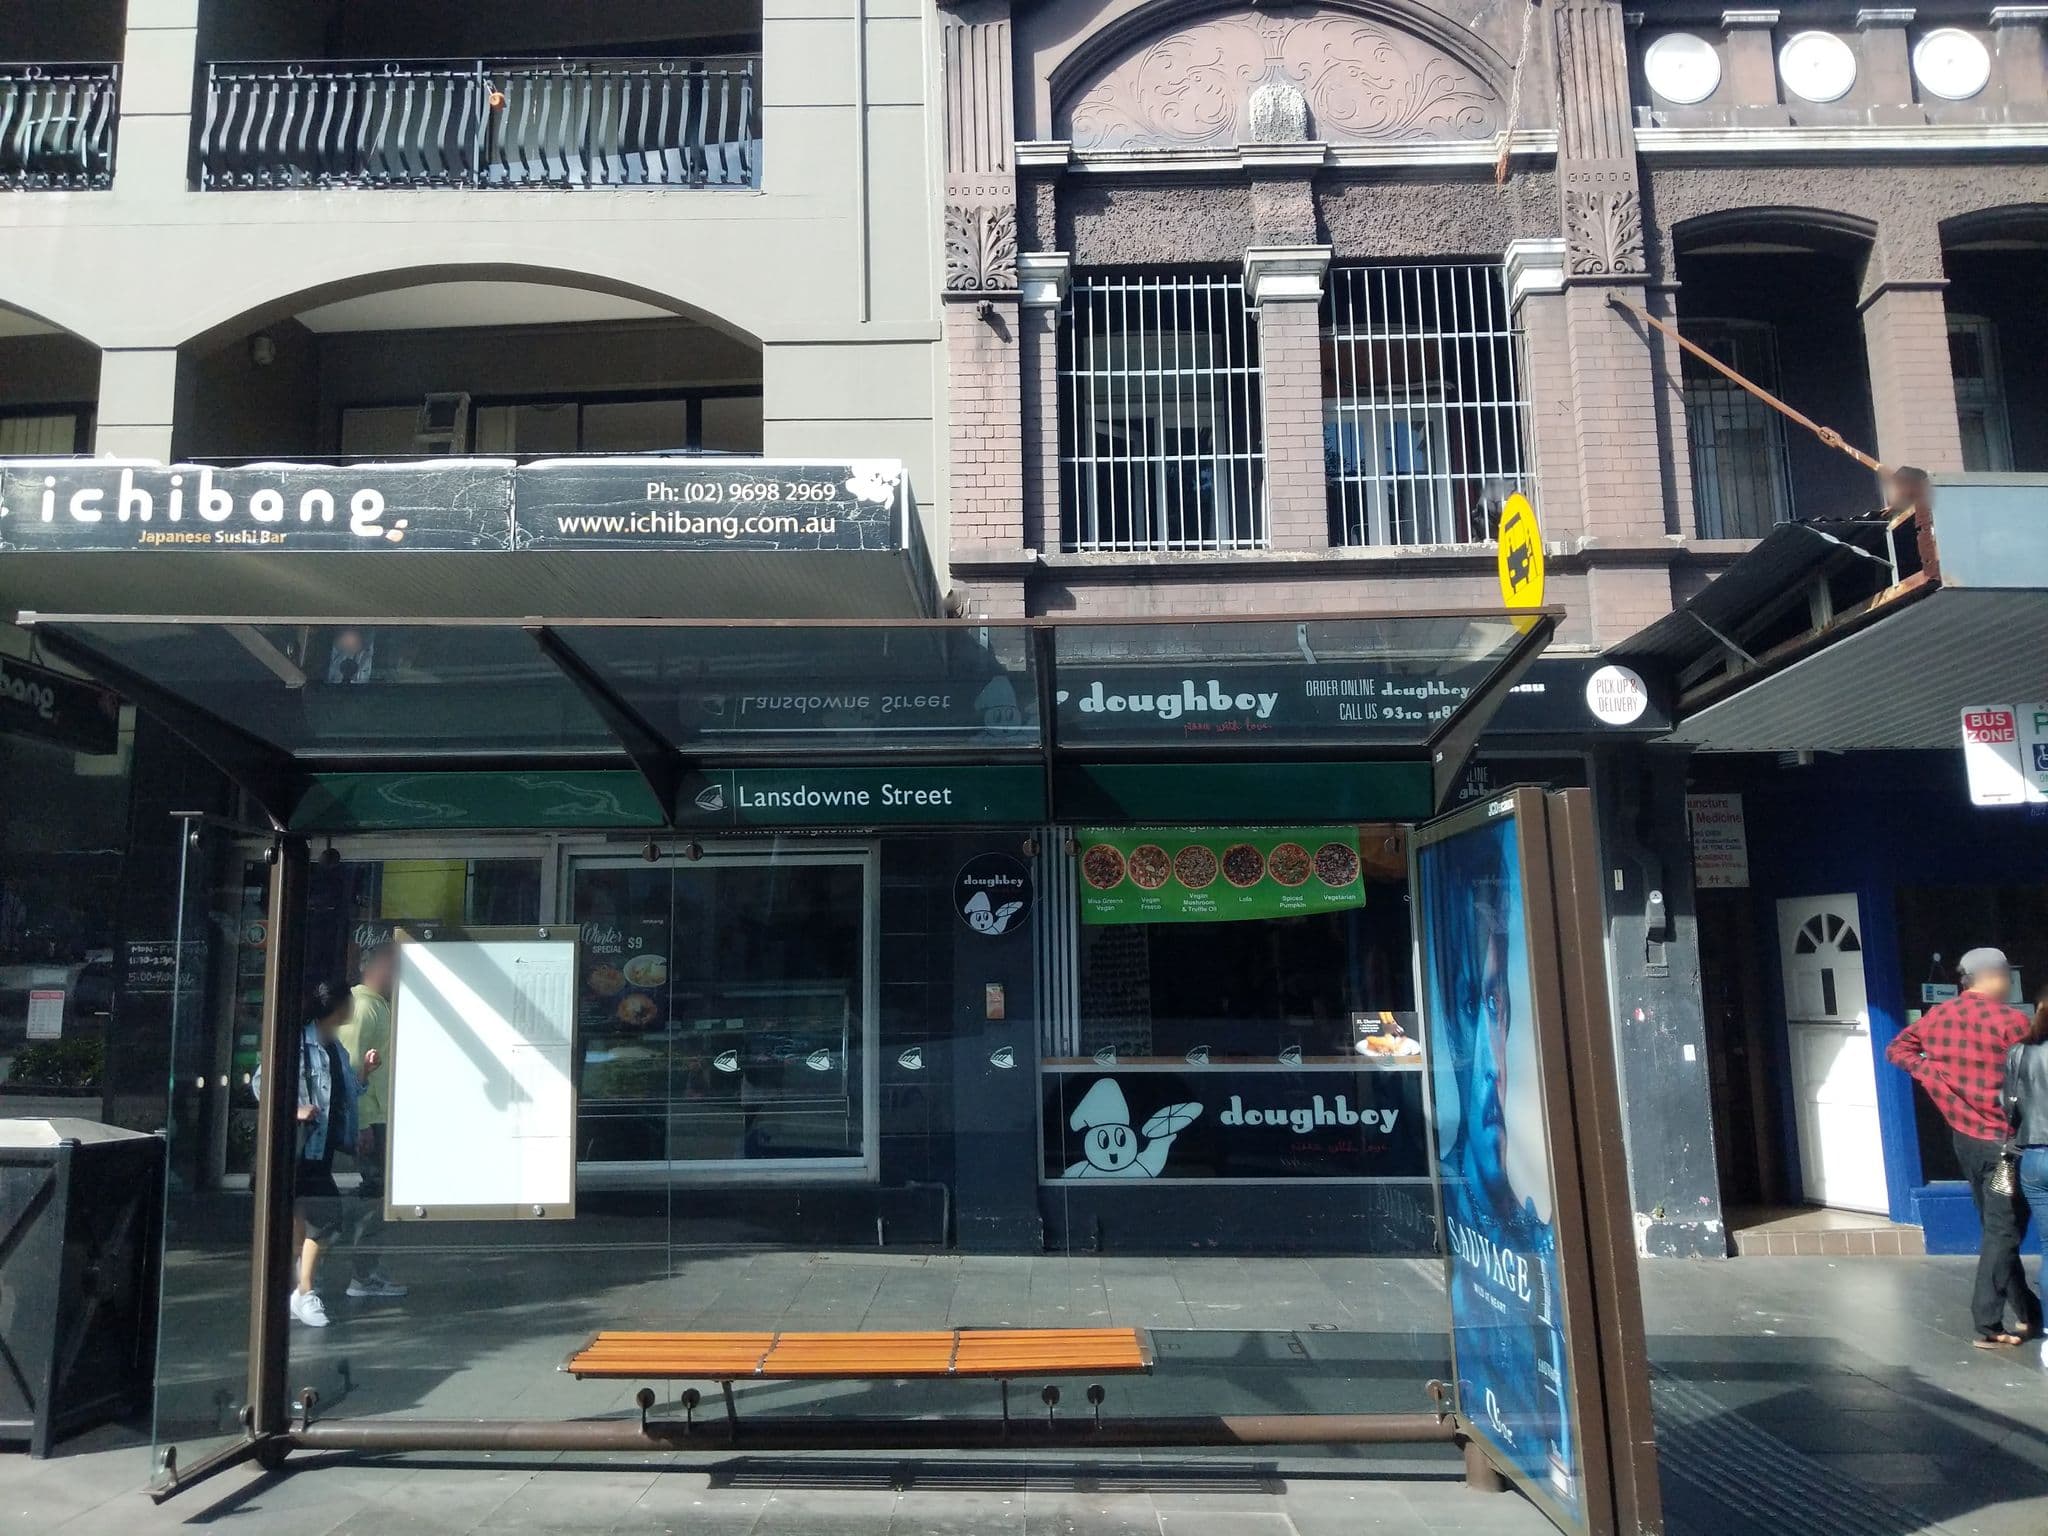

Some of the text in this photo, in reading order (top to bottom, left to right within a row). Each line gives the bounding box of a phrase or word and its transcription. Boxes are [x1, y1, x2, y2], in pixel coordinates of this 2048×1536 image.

[647, 482, 836, 502] Ph: (02) 9698 2969
[42, 468, 385, 537] ichibang
[558, 510, 836, 538] www.ichibang.com.au
[139, 530, 288, 547] Japanese Sushi Bar
[1306, 679, 1338, 697] ORDER
[1341, 678, 1376, 696] ONLINE
[1596, 678, 1638, 694] PICK UP &
[1079, 680, 1278, 719] doughboy
[1598, 696, 1638, 713] DELIVERY
[1339, 703, 1363, 721] CALL
[1365, 703, 1378, 720] US
[1382, 706, 1423, 720] 9310
[1971, 713, 2006, 727] BUS
[1967, 728, 2016, 742] ZONE
[739, 783, 952, 807] Lansdowne Street
[964, 874, 1024, 887] doughboy
[581, 921, 622, 945] Winter
[592, 944, 622, 954] SPECIAL
[627, 936, 643, 949] $9
[1220, 1095, 1399, 1134] doughboy
[1447, 1216, 1531, 1303] SAUVAGE
